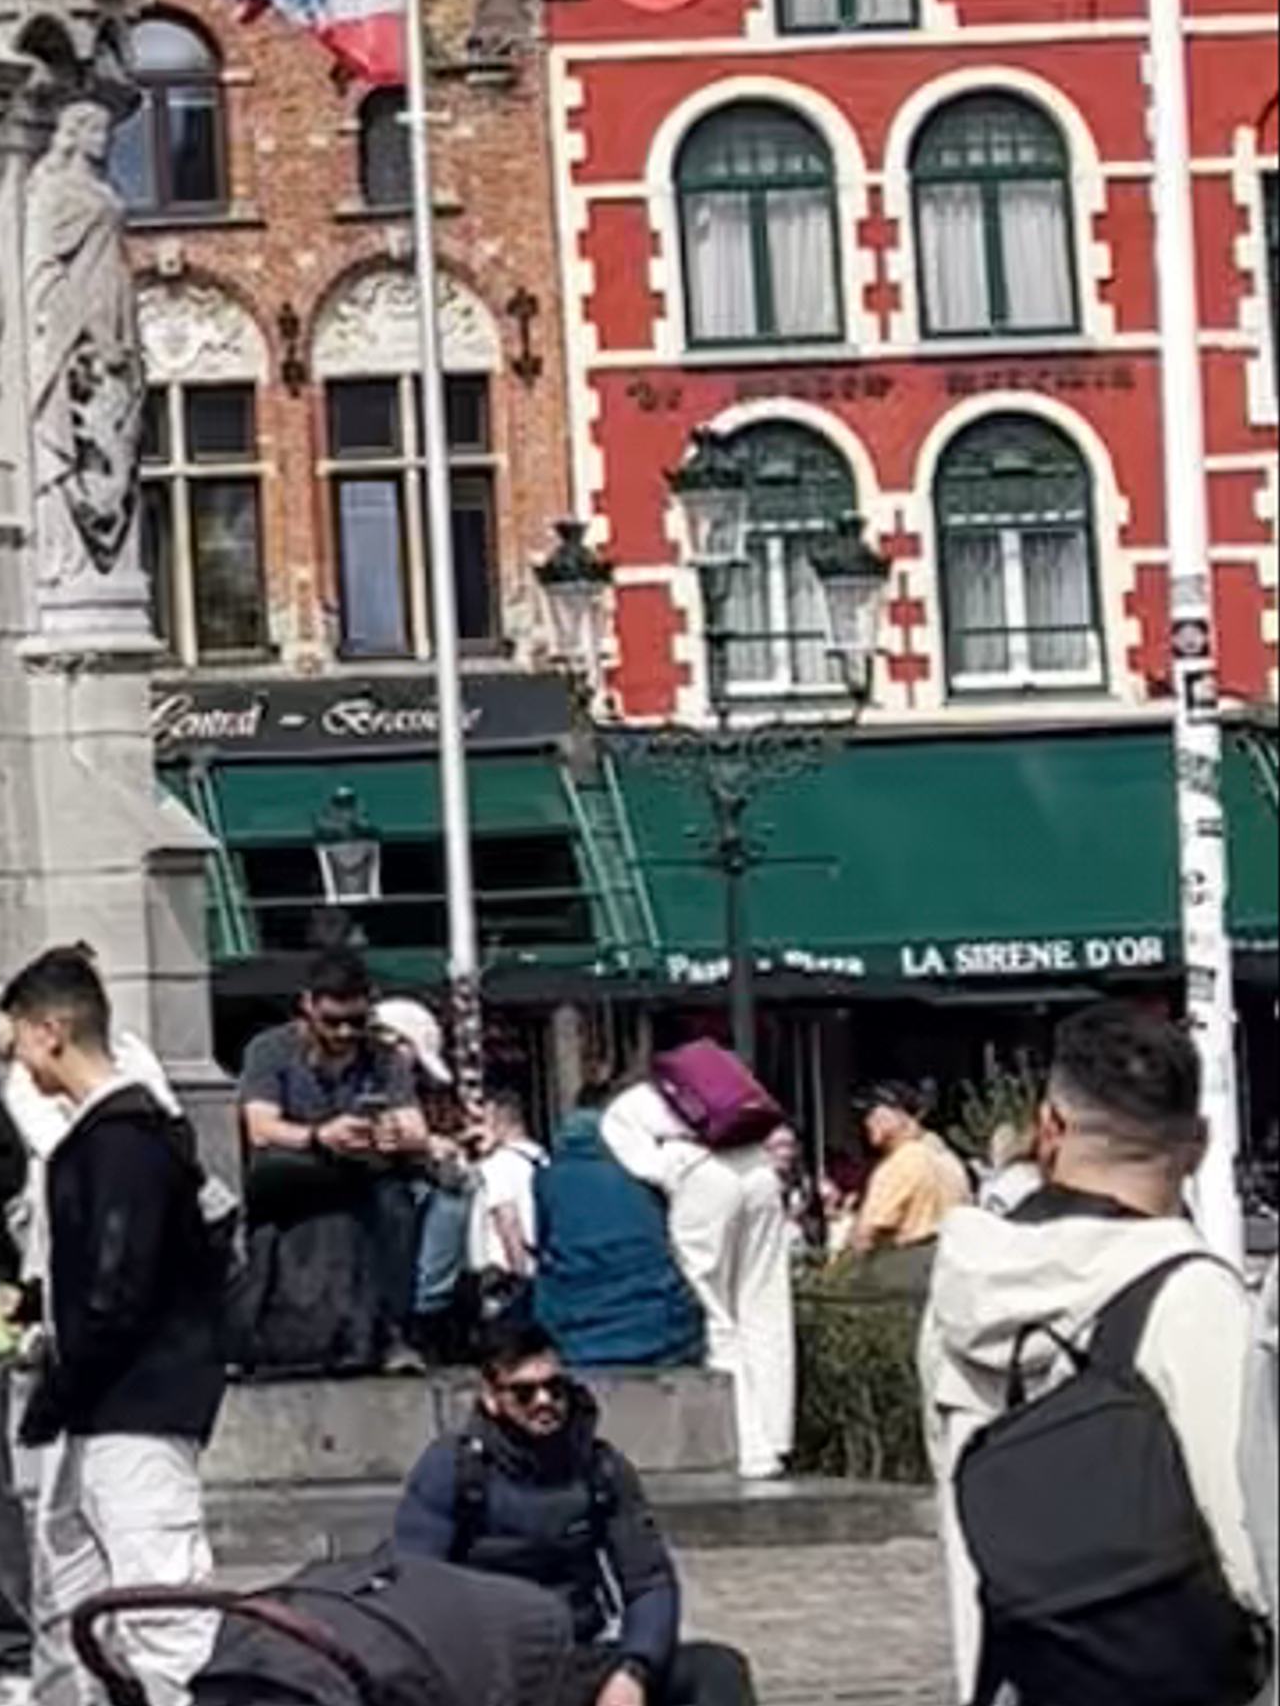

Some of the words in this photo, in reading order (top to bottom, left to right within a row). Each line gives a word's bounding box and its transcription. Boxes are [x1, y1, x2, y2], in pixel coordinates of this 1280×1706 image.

[900, 945, 946, 976] LA
[954, 941, 1078, 975] SIRENE
[1085, 936, 1164, 968] D'OR
